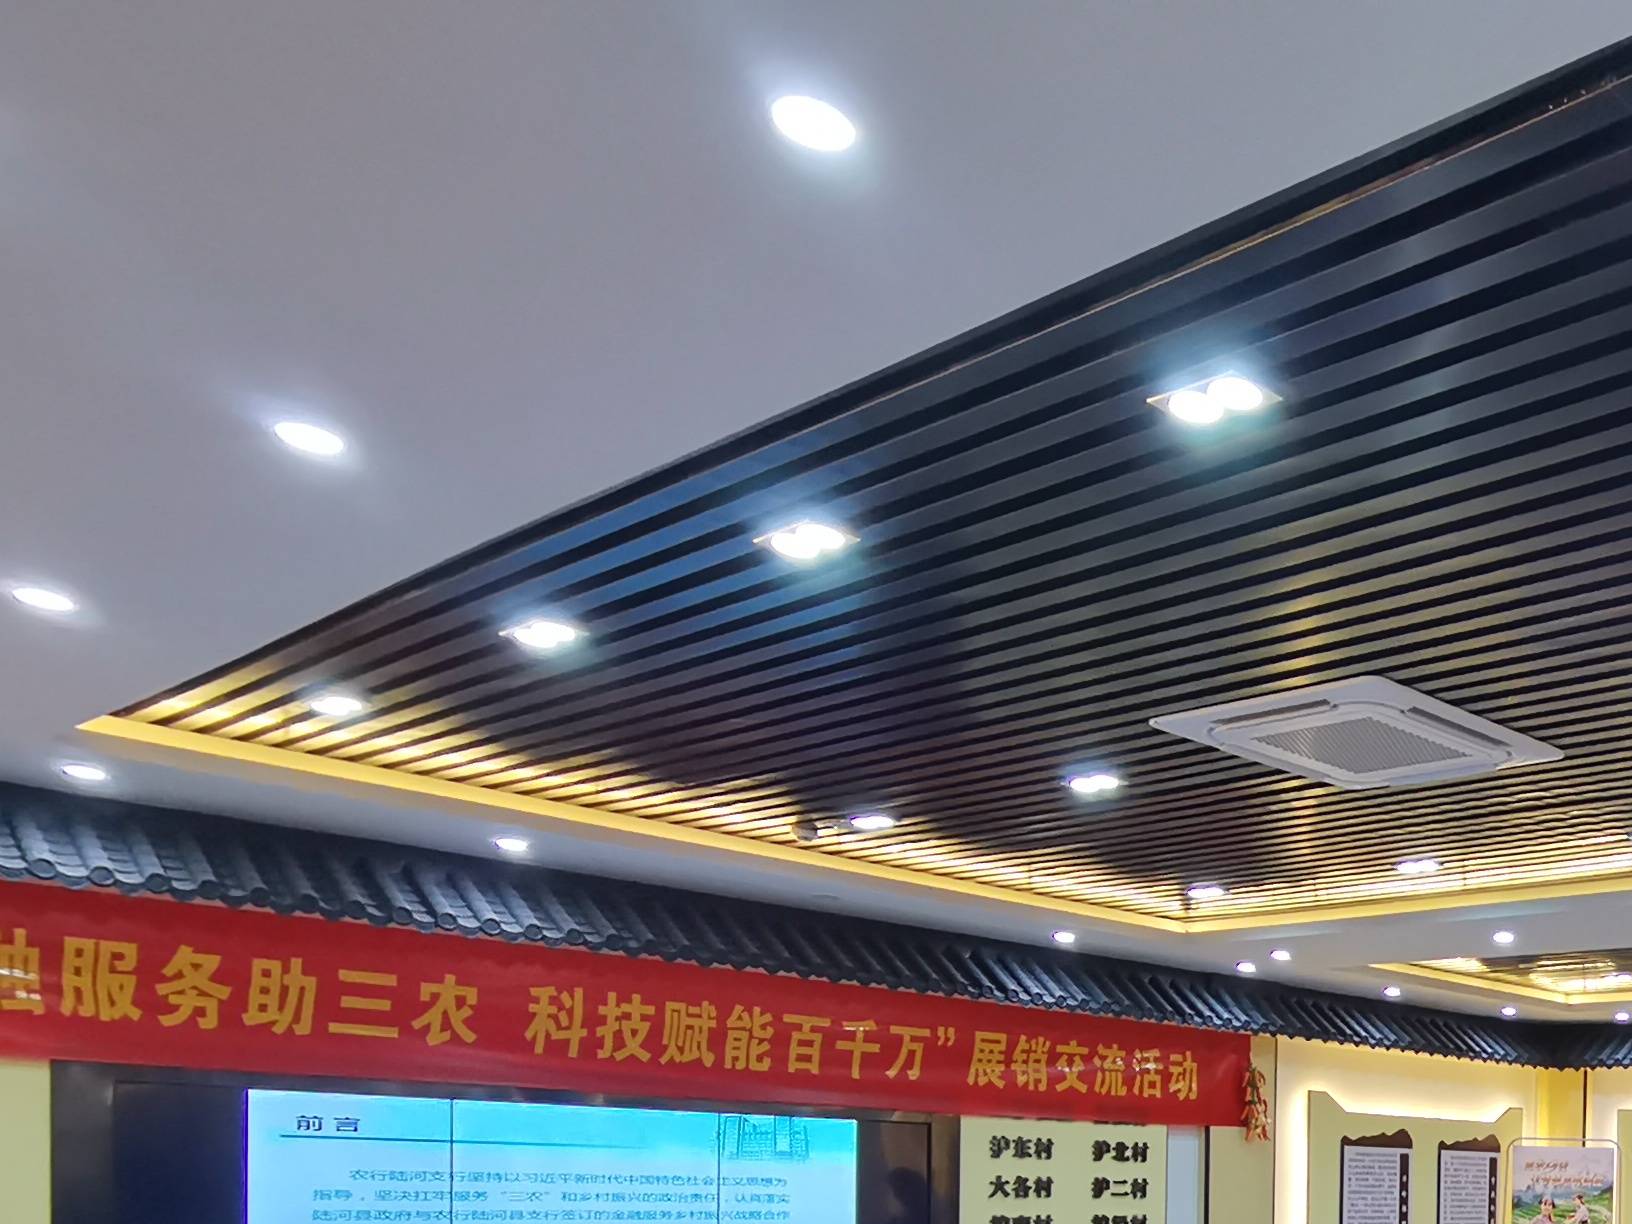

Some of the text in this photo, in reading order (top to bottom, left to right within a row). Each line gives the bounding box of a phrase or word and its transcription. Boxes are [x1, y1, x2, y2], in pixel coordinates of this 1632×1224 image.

[987, 1175, 1149, 1200] 大各村 护二村
